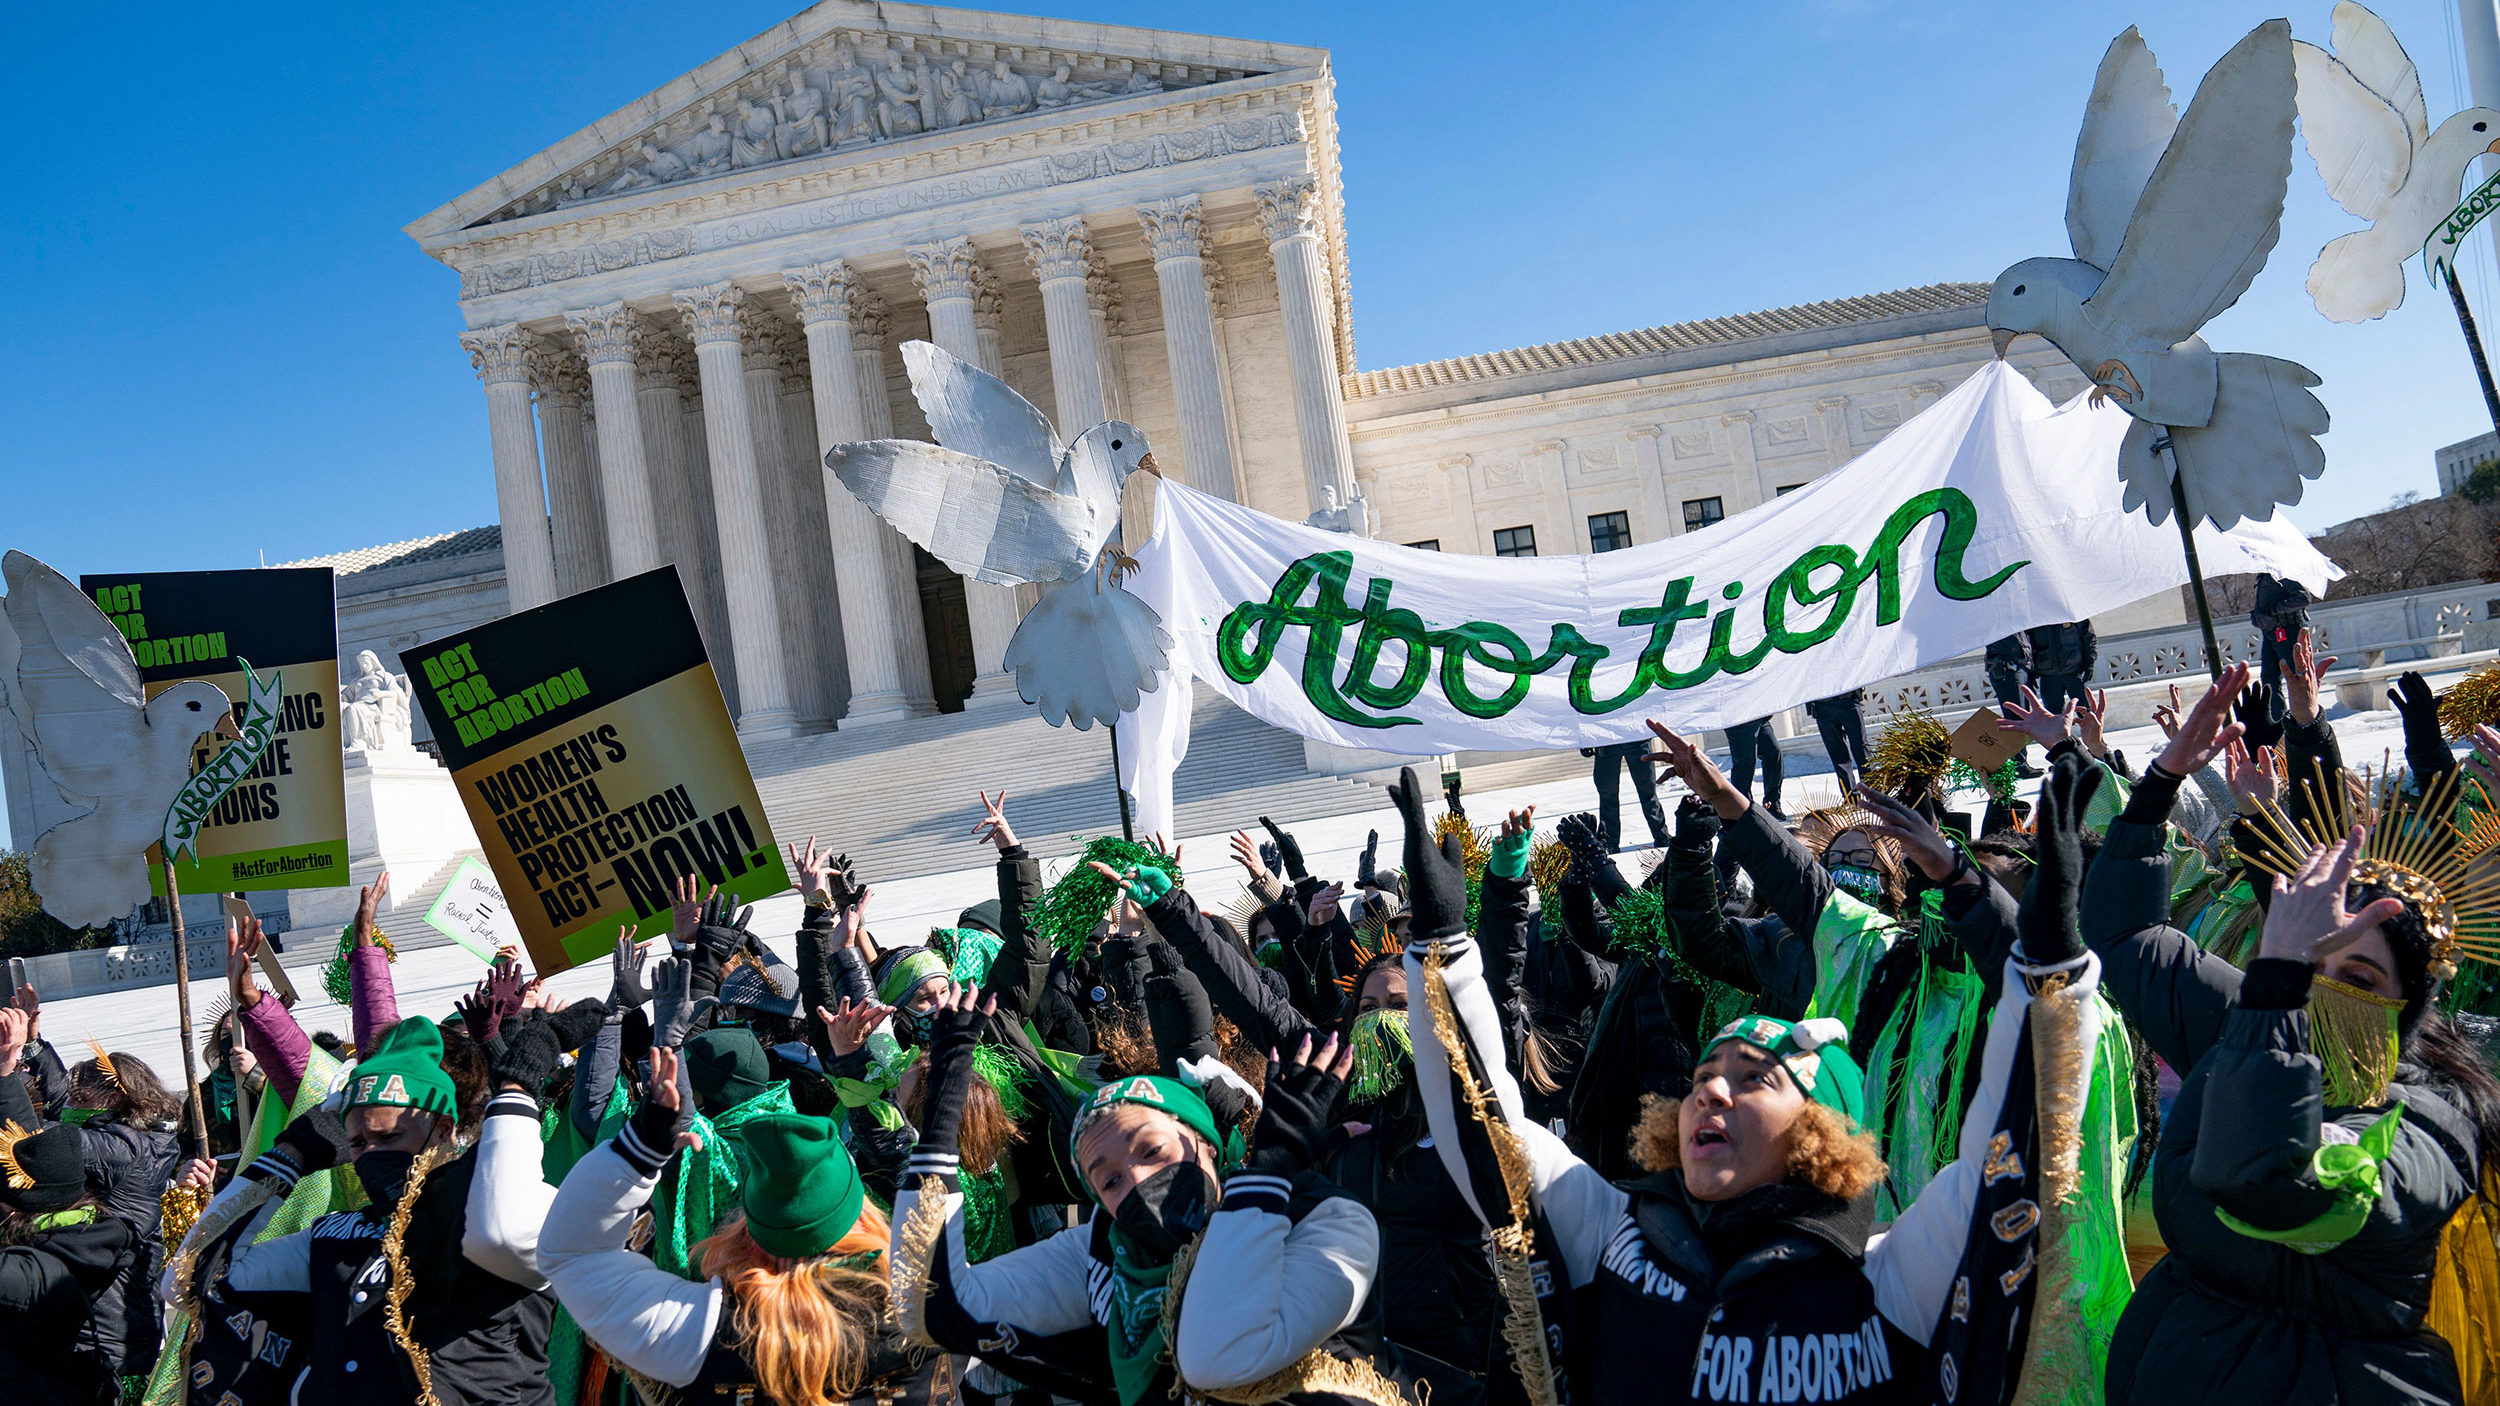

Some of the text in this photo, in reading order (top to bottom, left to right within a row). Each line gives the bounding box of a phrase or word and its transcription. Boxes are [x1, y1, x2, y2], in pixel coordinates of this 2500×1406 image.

[712, 168, 1028, 245] EQUAL JUSTICE UNDER LAW
[96, 584, 142, 614] ACT
[109, 613, 149, 641] OR
[1217, 486, 2032, 728] Abortion
[422, 642, 479, 690] ACT
[436, 674, 498, 719] FOR
[454, 666, 591, 748] ABORTION
[174, 699, 273, 839] ABORTION
[475, 724, 627, 816] WOMEN'S
[496, 778, 610, 855] HEALTH
[517, 784, 698, 892] PROTECTION
[232, 853, 334, 880] #ActForAbortion
[444, 902, 473, 924] Racial
[1691, 1334, 1753, 1403] FOR
